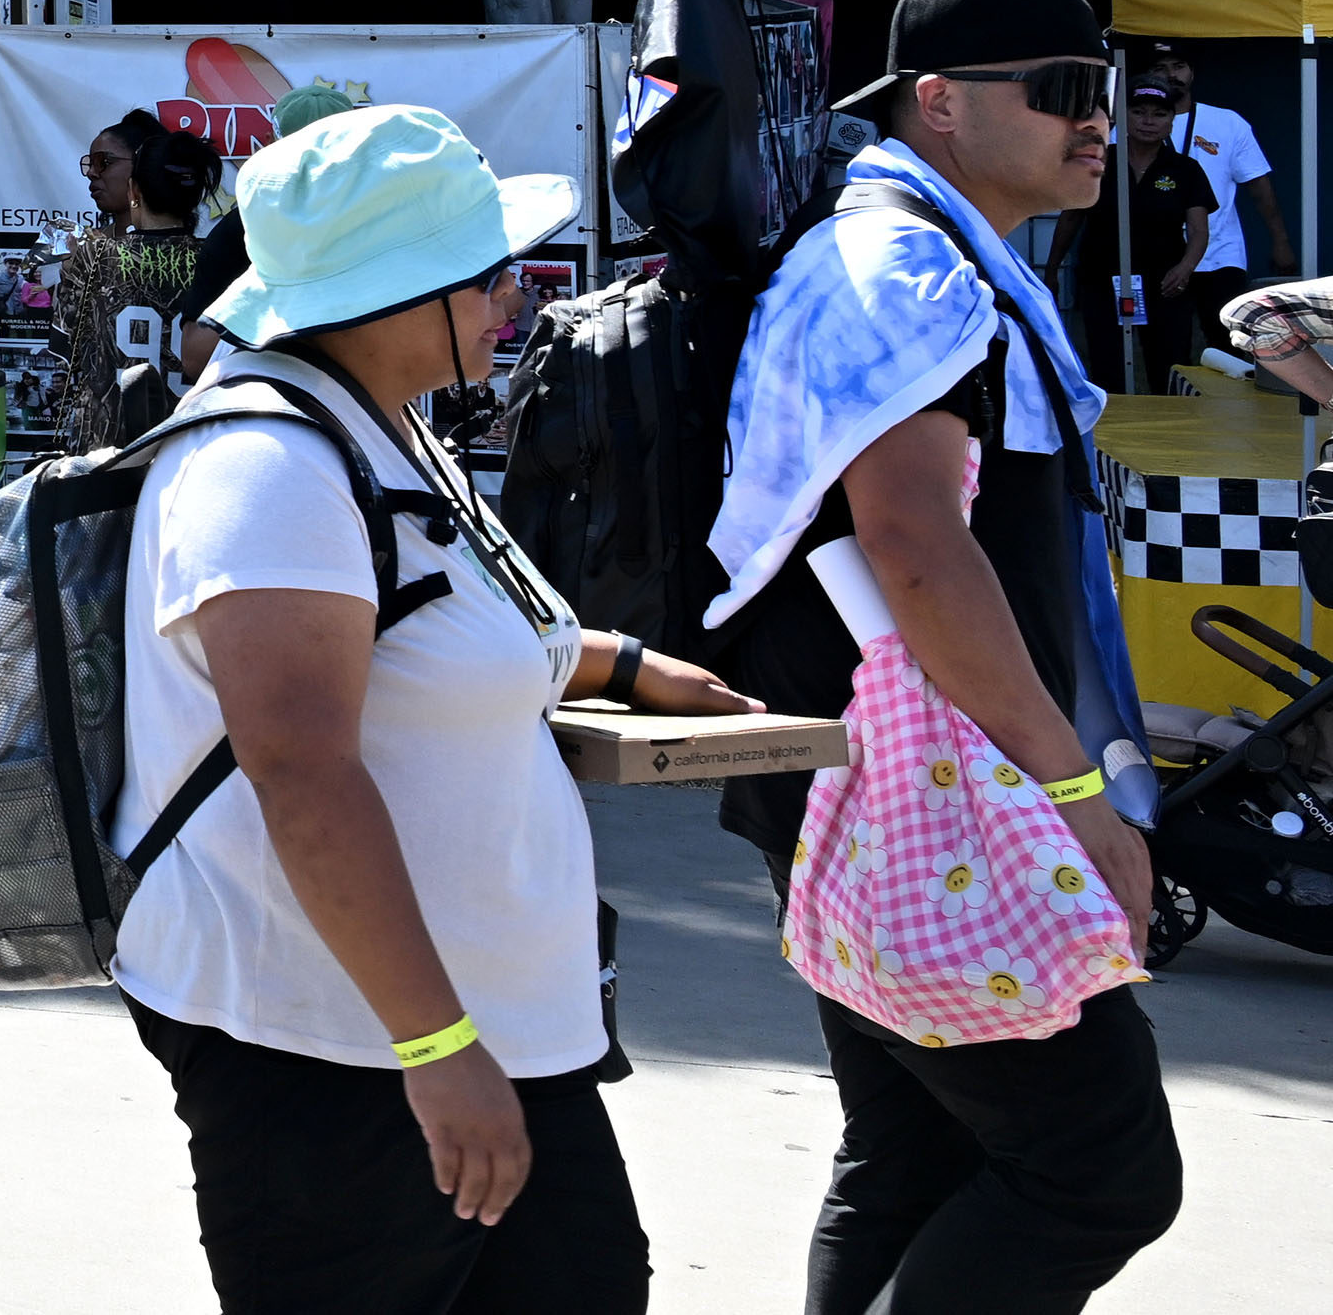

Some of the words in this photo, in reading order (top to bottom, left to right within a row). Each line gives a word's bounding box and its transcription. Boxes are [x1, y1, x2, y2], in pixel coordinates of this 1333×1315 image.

[674, 750, 730, 766] california
[733, 749, 765, 763] pizza
[767, 745, 812, 761] kitchen
[1061, 786, 1085, 797] ARMY
[1303, 797, 1333, 836] bomb
